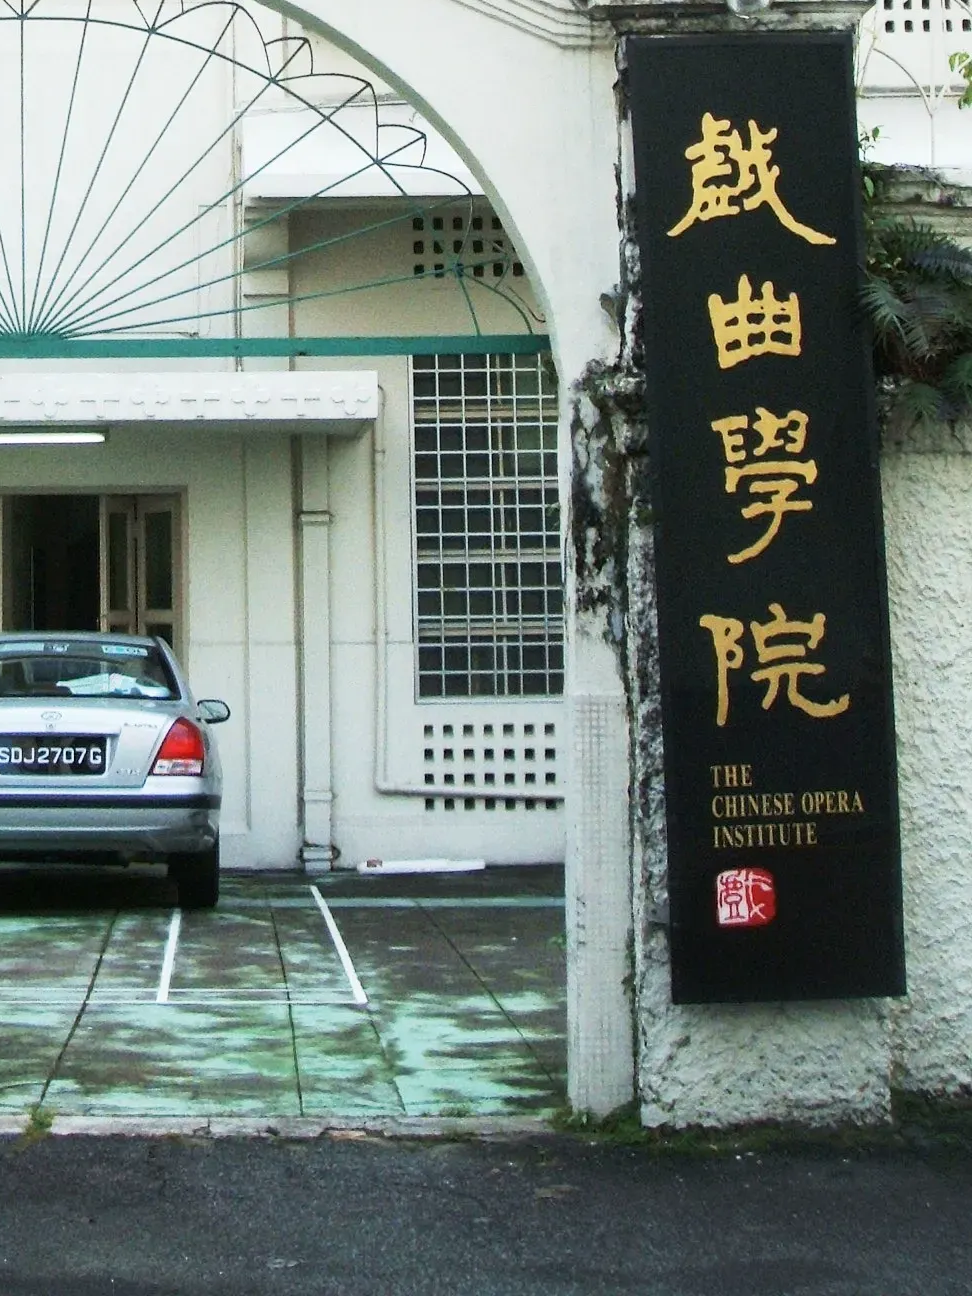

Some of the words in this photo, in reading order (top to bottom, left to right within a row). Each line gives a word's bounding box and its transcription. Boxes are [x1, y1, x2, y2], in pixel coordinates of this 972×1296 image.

[710, 764, 753, 788] THE
[711, 792, 795, 818] CHINESE
[801, 790, 865, 815] OPERA
[713, 821, 818, 848] INSTITUTE
